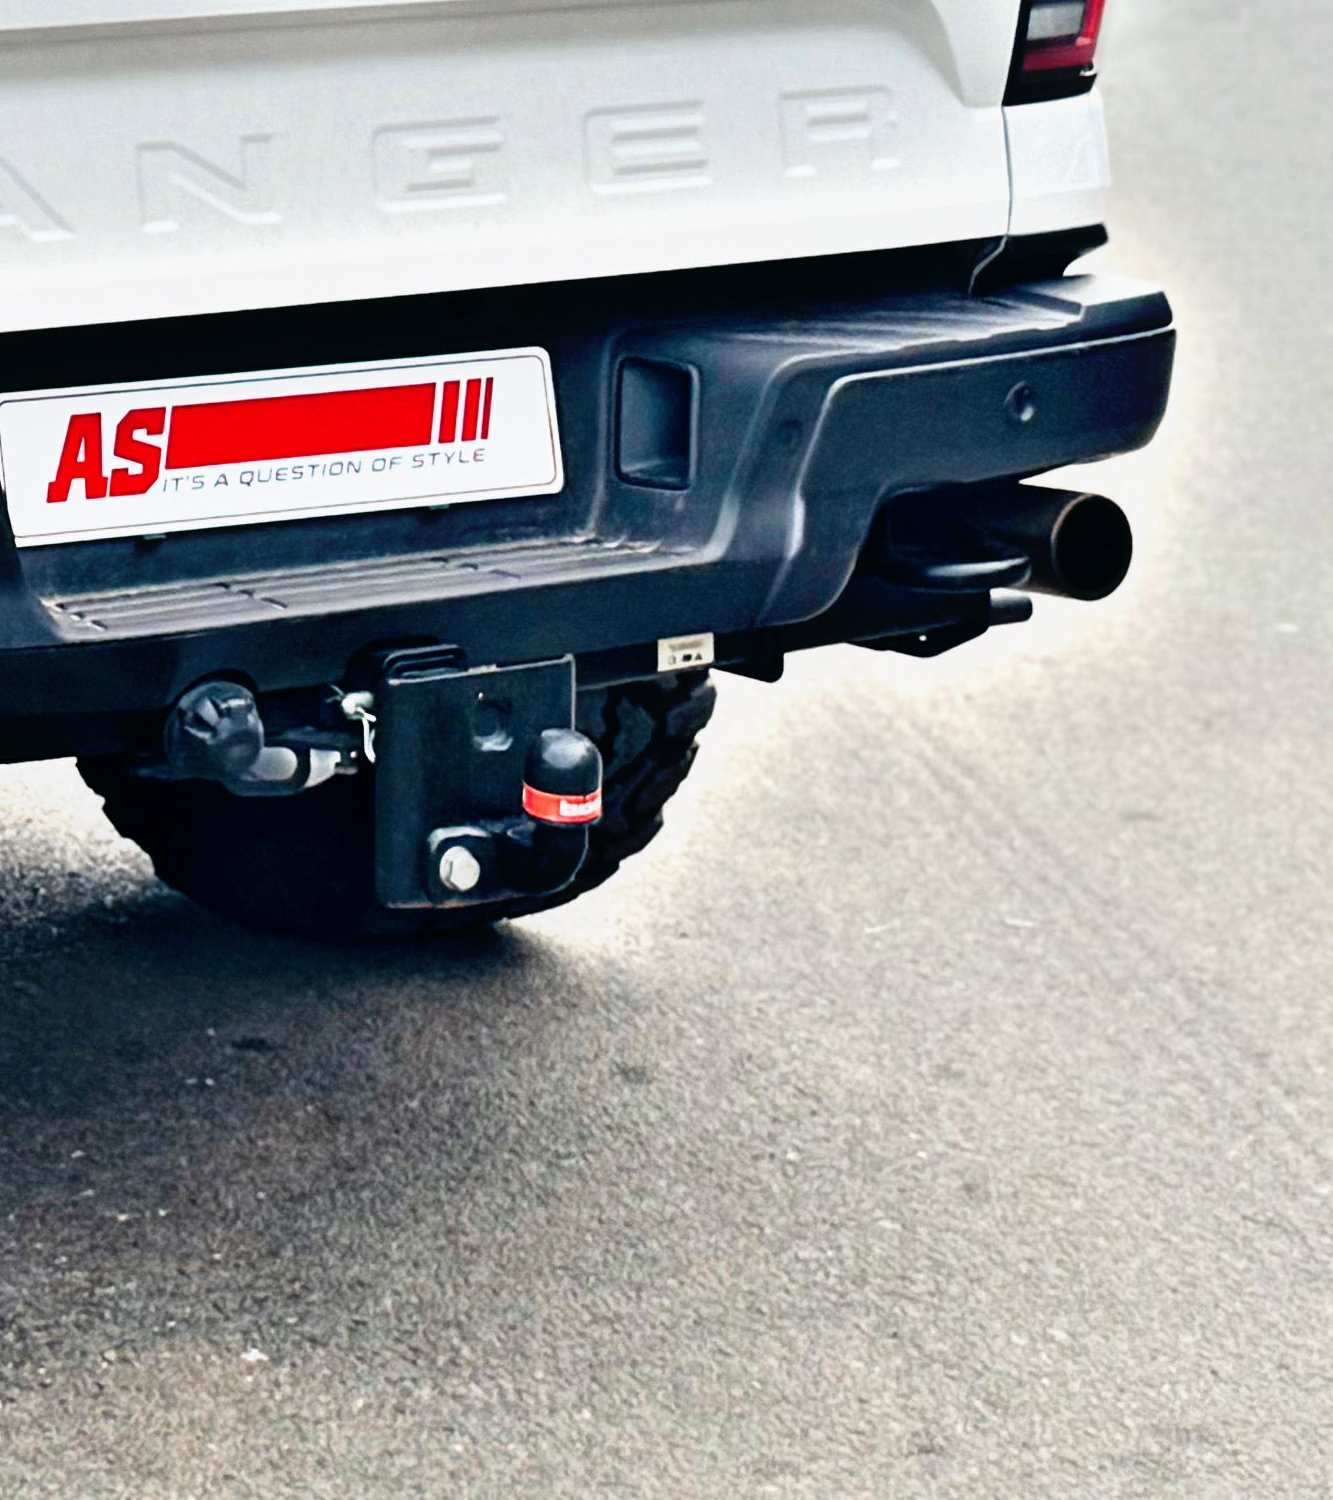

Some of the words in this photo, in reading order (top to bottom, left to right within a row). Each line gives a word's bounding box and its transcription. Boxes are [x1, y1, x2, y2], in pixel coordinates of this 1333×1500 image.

[46, 405, 167, 504] AS
[162, 474, 206, 493] IT'S
[213, 472, 230, 488] A
[238, 458, 364, 487] QUESTION
[370, 454, 404, 473] OF
[410, 447, 486, 470] STYLE
